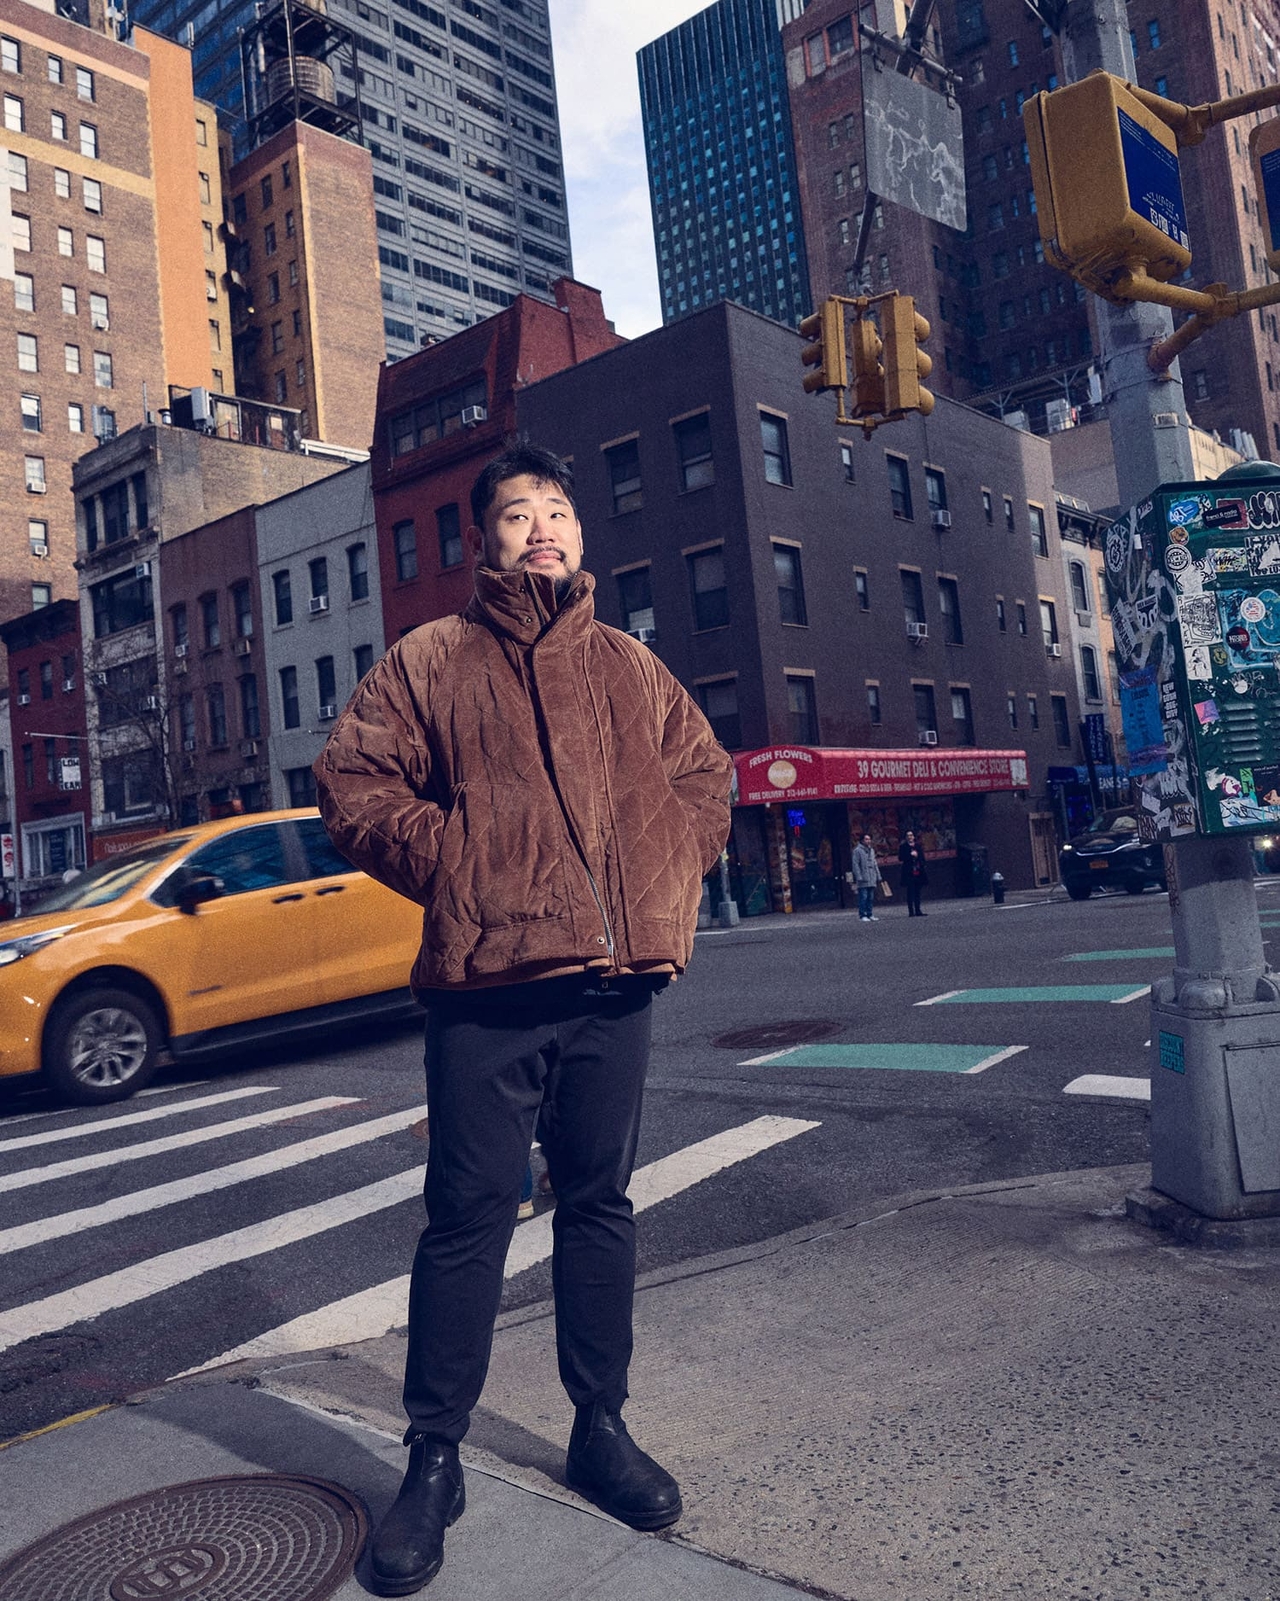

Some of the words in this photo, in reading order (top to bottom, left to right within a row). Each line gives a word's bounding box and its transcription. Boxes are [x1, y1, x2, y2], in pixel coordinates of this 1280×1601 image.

[749, 751, 772, 768] FRESH
[774, 750, 813, 763] FLOWERS
[857, 760, 869, 778] 39
[871, 760, 911, 778] GOURMET
[912, 761, 929, 778] DELI
[930, 761, 937, 777] &
[938, 760, 988, 777] CONVENIENCE
[988, 758, 1009, 774] STORE
[748, 791, 761, 801] FREE
[762, 790, 785, 800] DELIVERY
